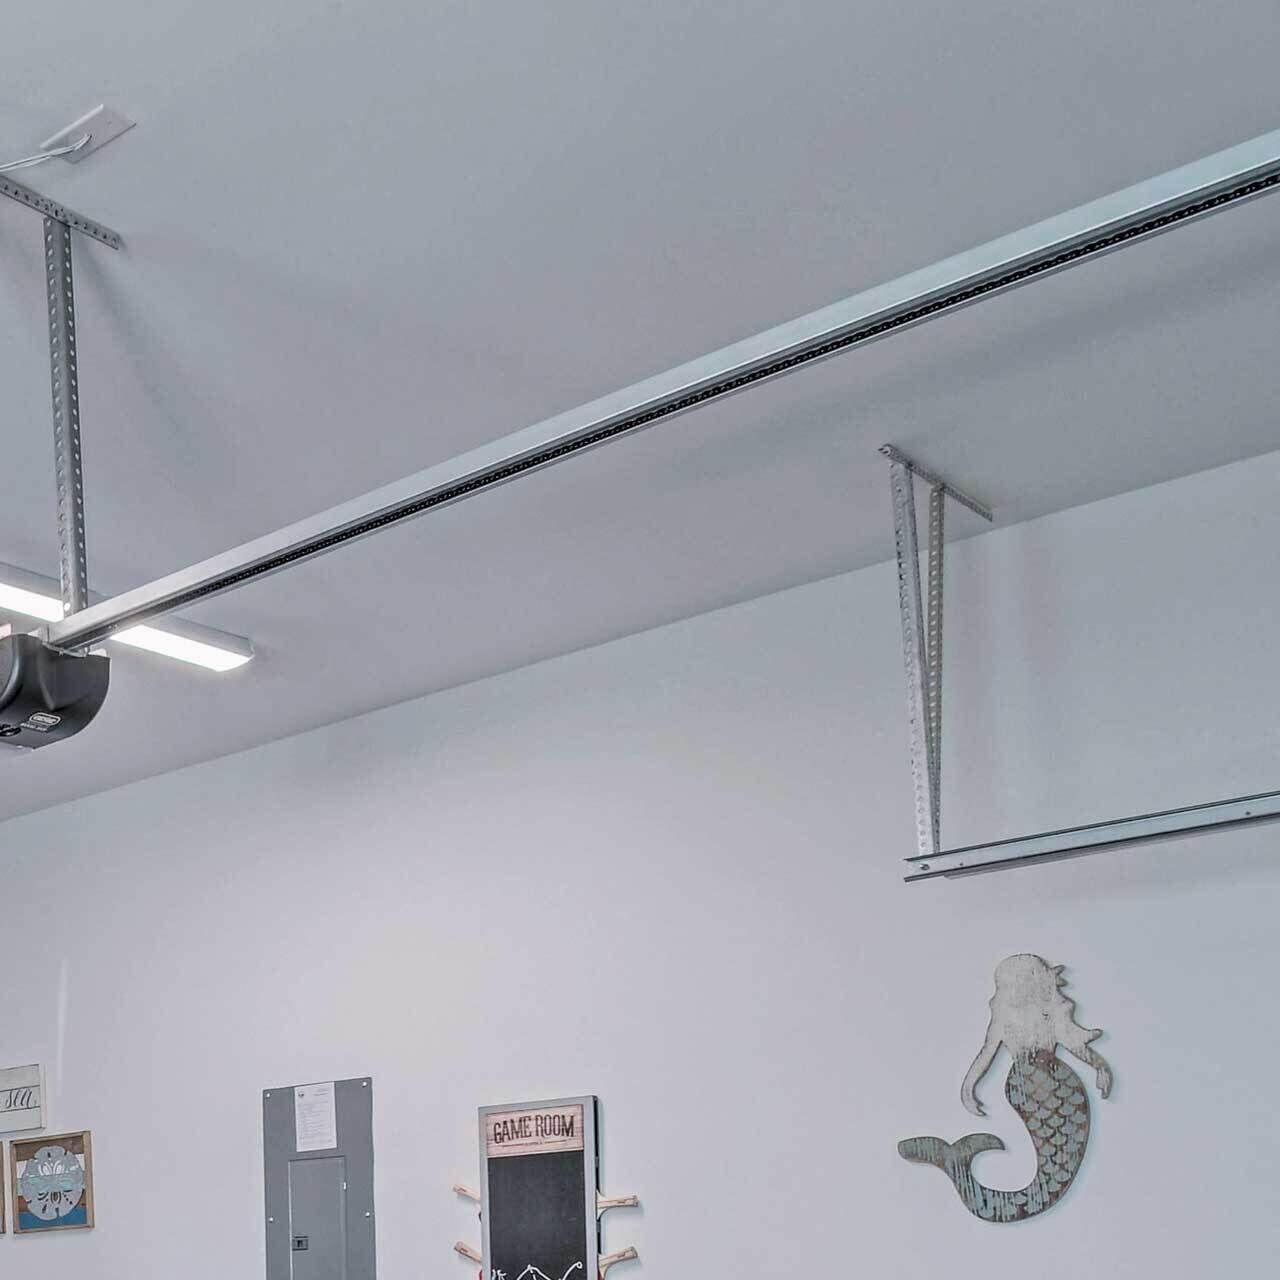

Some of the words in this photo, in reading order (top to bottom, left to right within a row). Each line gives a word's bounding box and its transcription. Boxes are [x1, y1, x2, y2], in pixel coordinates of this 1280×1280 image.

[4, 1087, 37, 1110] sea
[493, 1115, 532, 1144] GAME
[535, 1114, 575, 1138] ROOM
